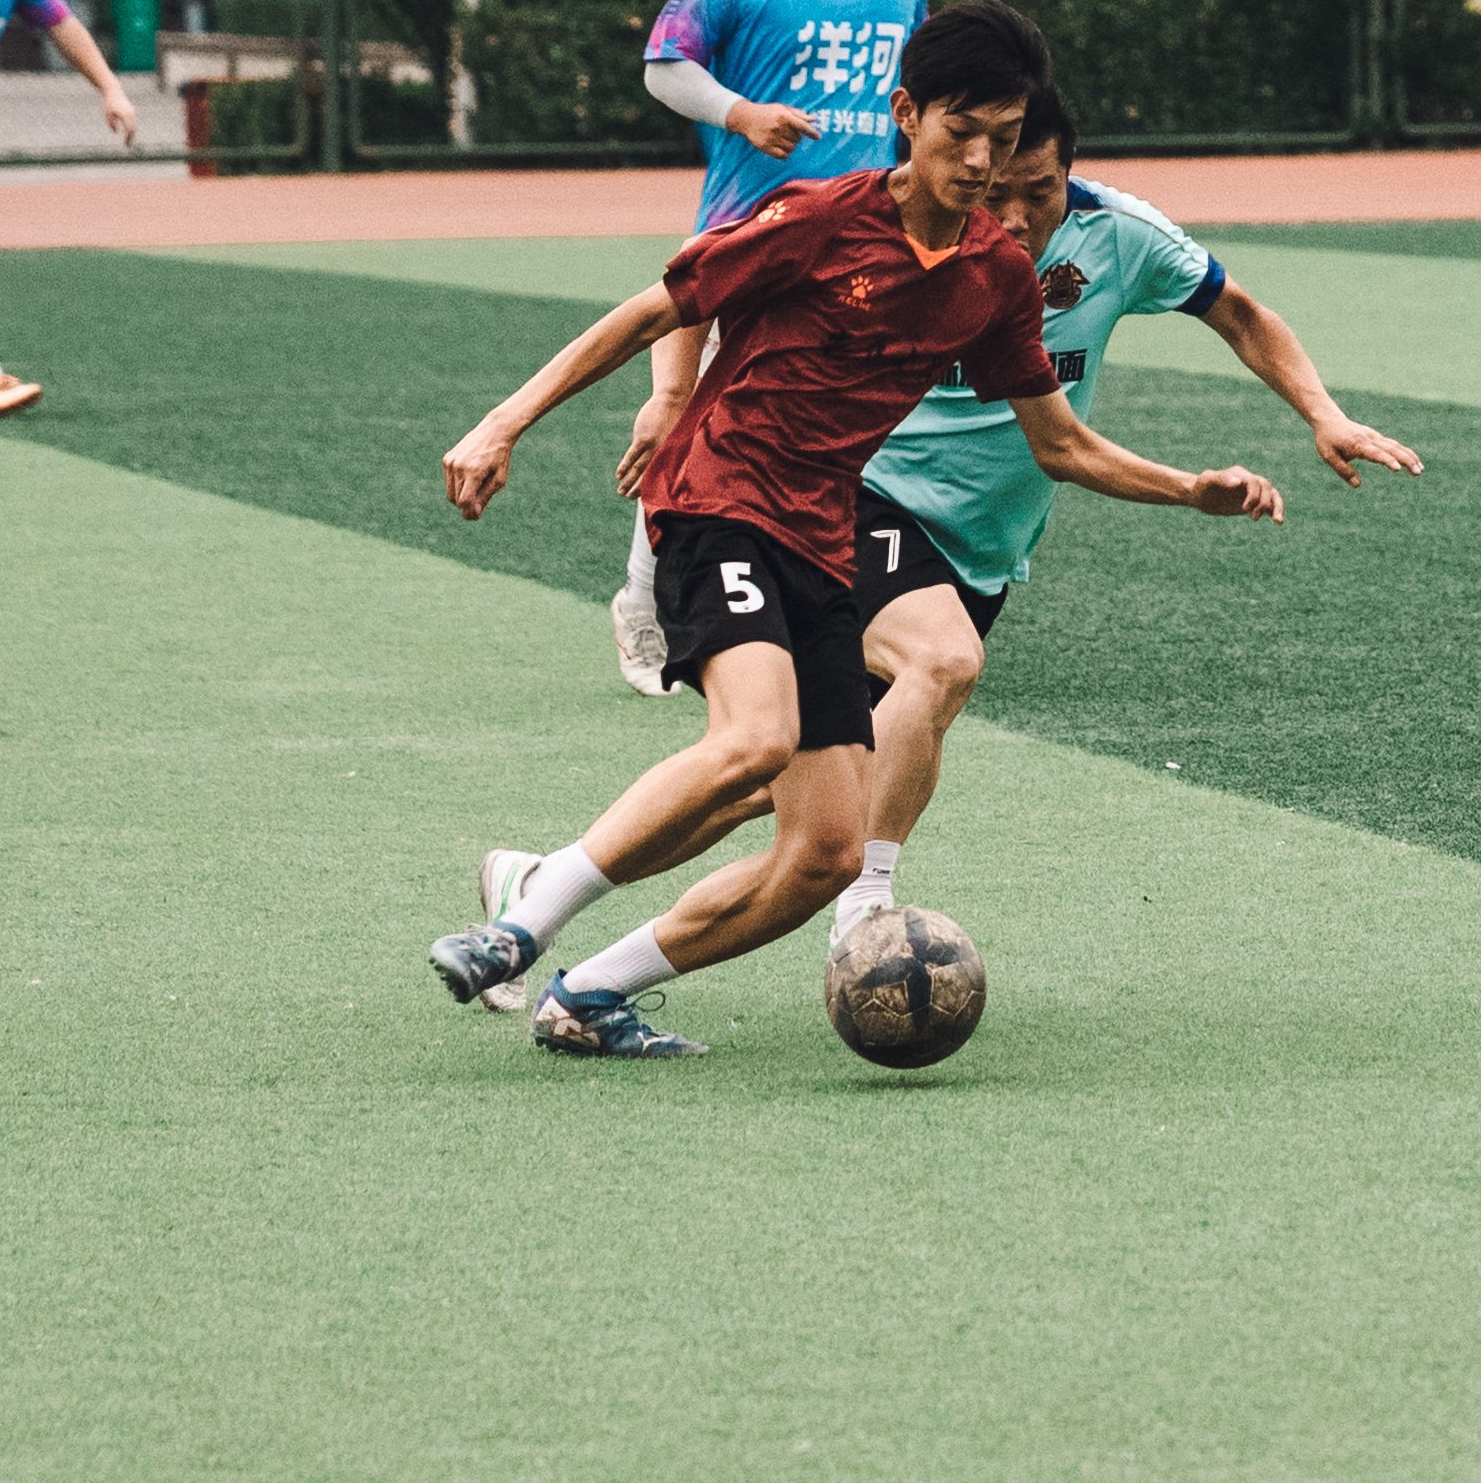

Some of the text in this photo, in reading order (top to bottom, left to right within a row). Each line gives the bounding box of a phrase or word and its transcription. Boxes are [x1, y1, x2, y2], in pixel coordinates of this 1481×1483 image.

[789, 20, 906, 96] 洋河
[870, 529, 901, 573] 7
[719, 561, 765, 613] 5
